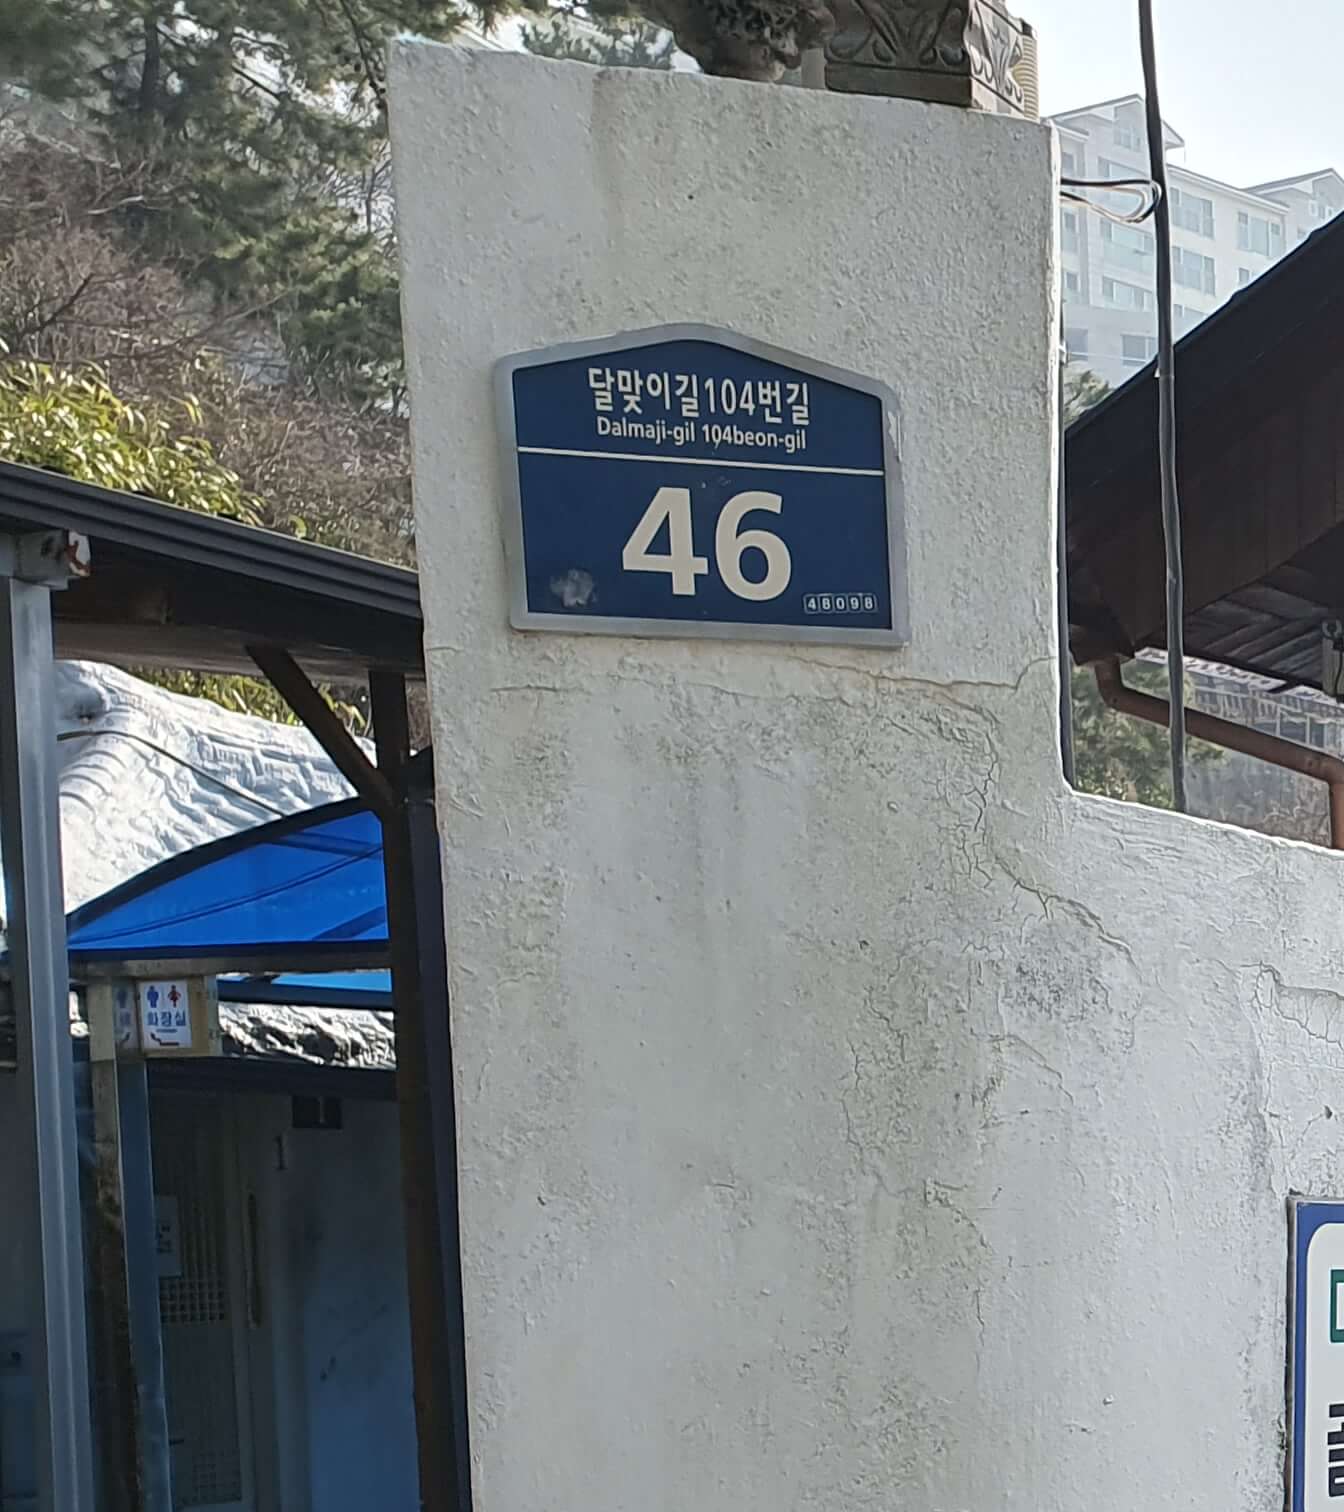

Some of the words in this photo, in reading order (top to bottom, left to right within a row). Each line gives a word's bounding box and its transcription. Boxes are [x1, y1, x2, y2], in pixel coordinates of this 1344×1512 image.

[589, 368, 809, 425] 달맞이길104번길
[597, 416, 695, 445] Dalmaji-gil
[701, 423, 807, 453] 104beon-gil
[622, 486, 792, 602] 46
[805, 594, 876, 613] 48098
[147, 1011, 186, 1027] 화장실
